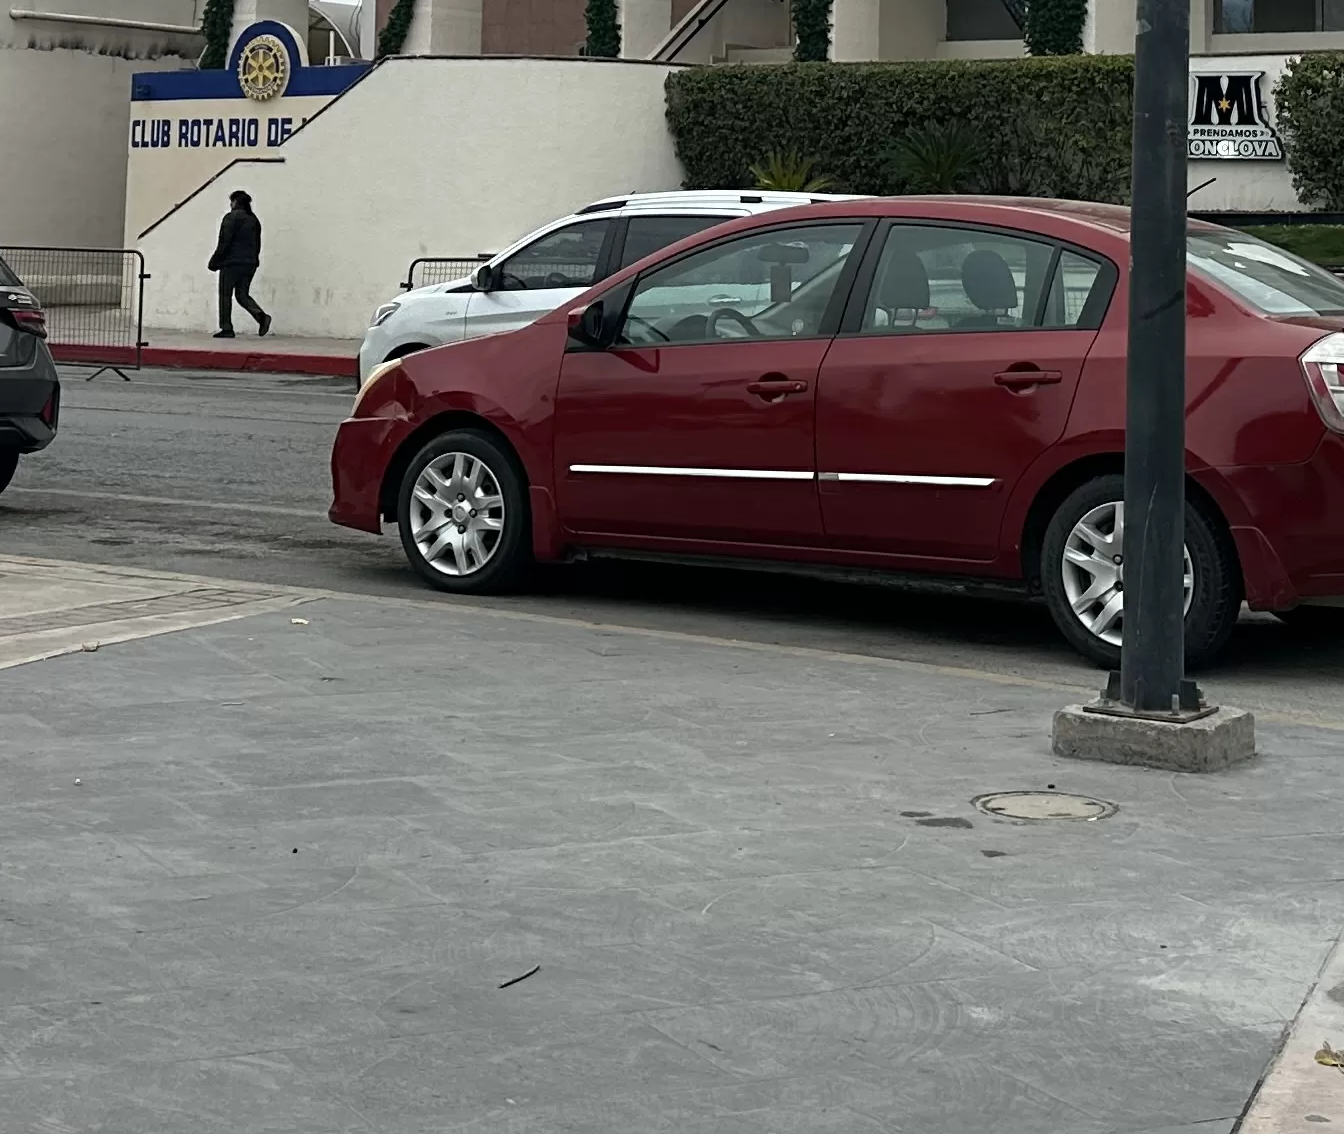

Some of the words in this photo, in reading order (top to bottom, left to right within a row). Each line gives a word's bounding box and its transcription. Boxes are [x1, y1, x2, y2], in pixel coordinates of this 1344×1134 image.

[131, 119, 171, 148] CLUB
[178, 118, 259, 148] ROTARIO
[266, 118, 293, 147] DE
[1193, 128, 1258, 138] PRENDAMOS
[1187, 139, 1278, 157] ONCLOVA
